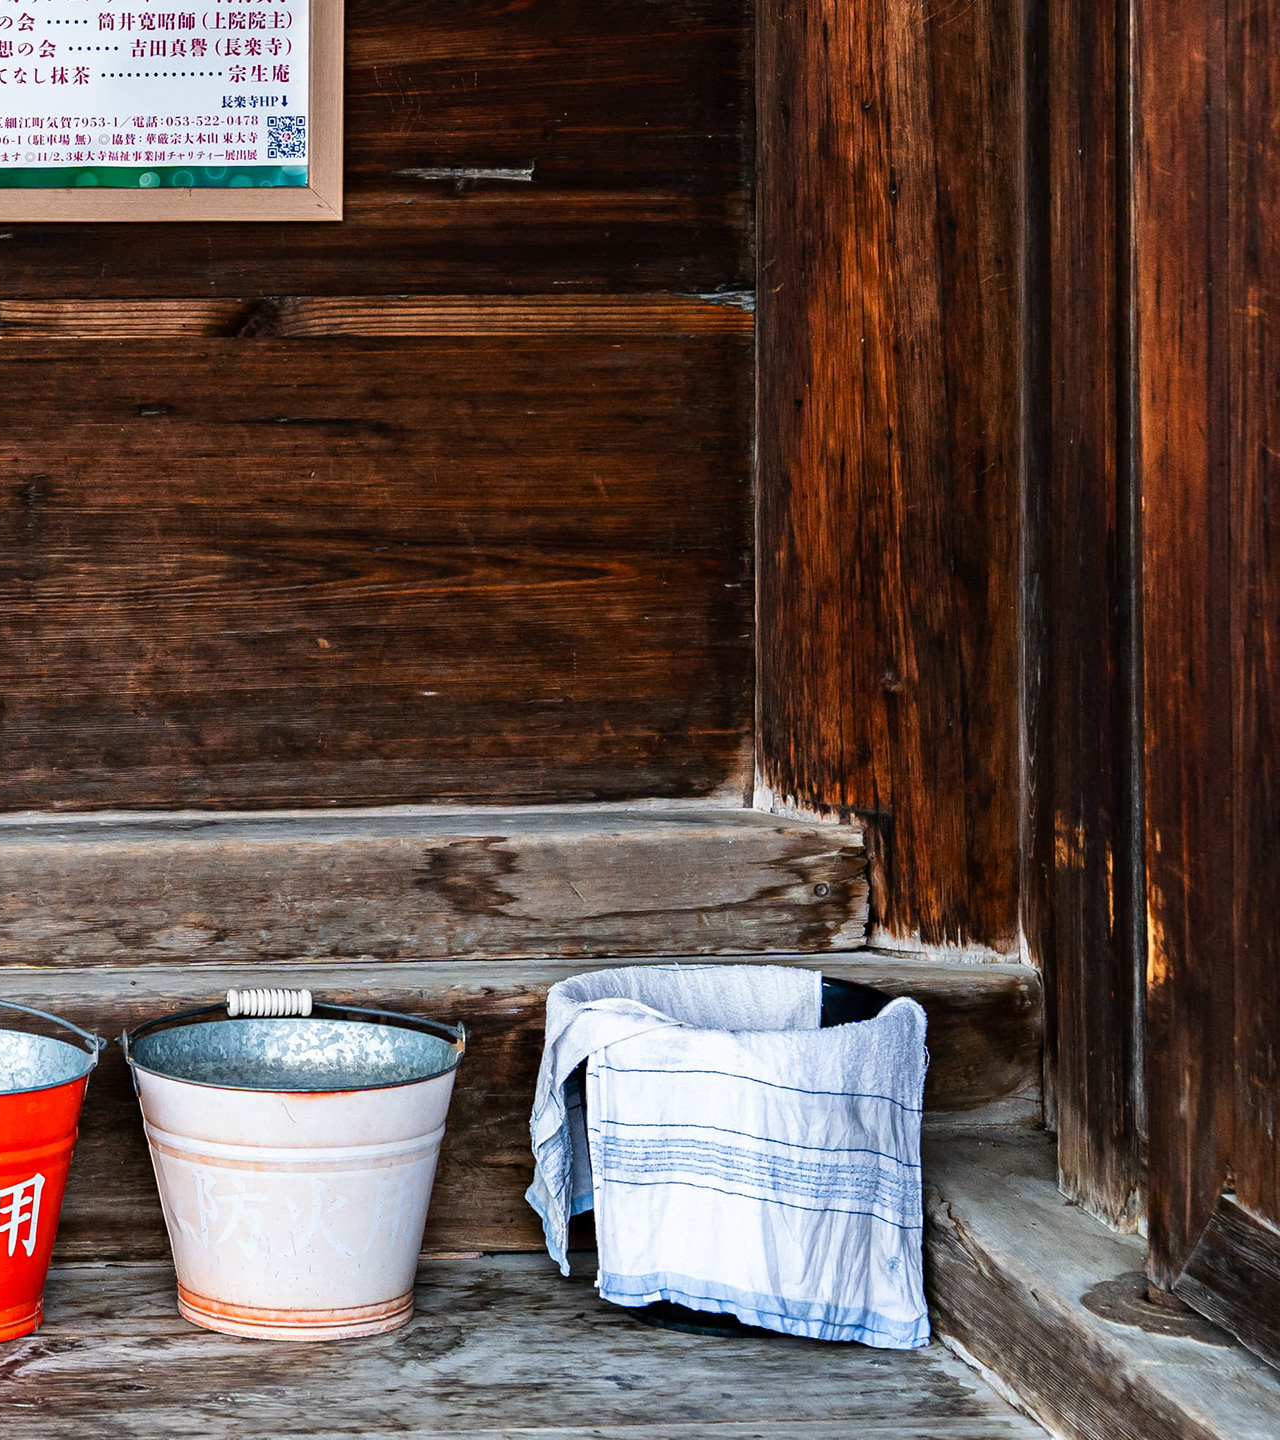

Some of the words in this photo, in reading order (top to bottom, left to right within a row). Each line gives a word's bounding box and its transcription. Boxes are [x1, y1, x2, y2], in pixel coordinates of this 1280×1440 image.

[228, 63, 291, 84] 宗生庵
[221, 94, 280, 109] 長楽寺HP
